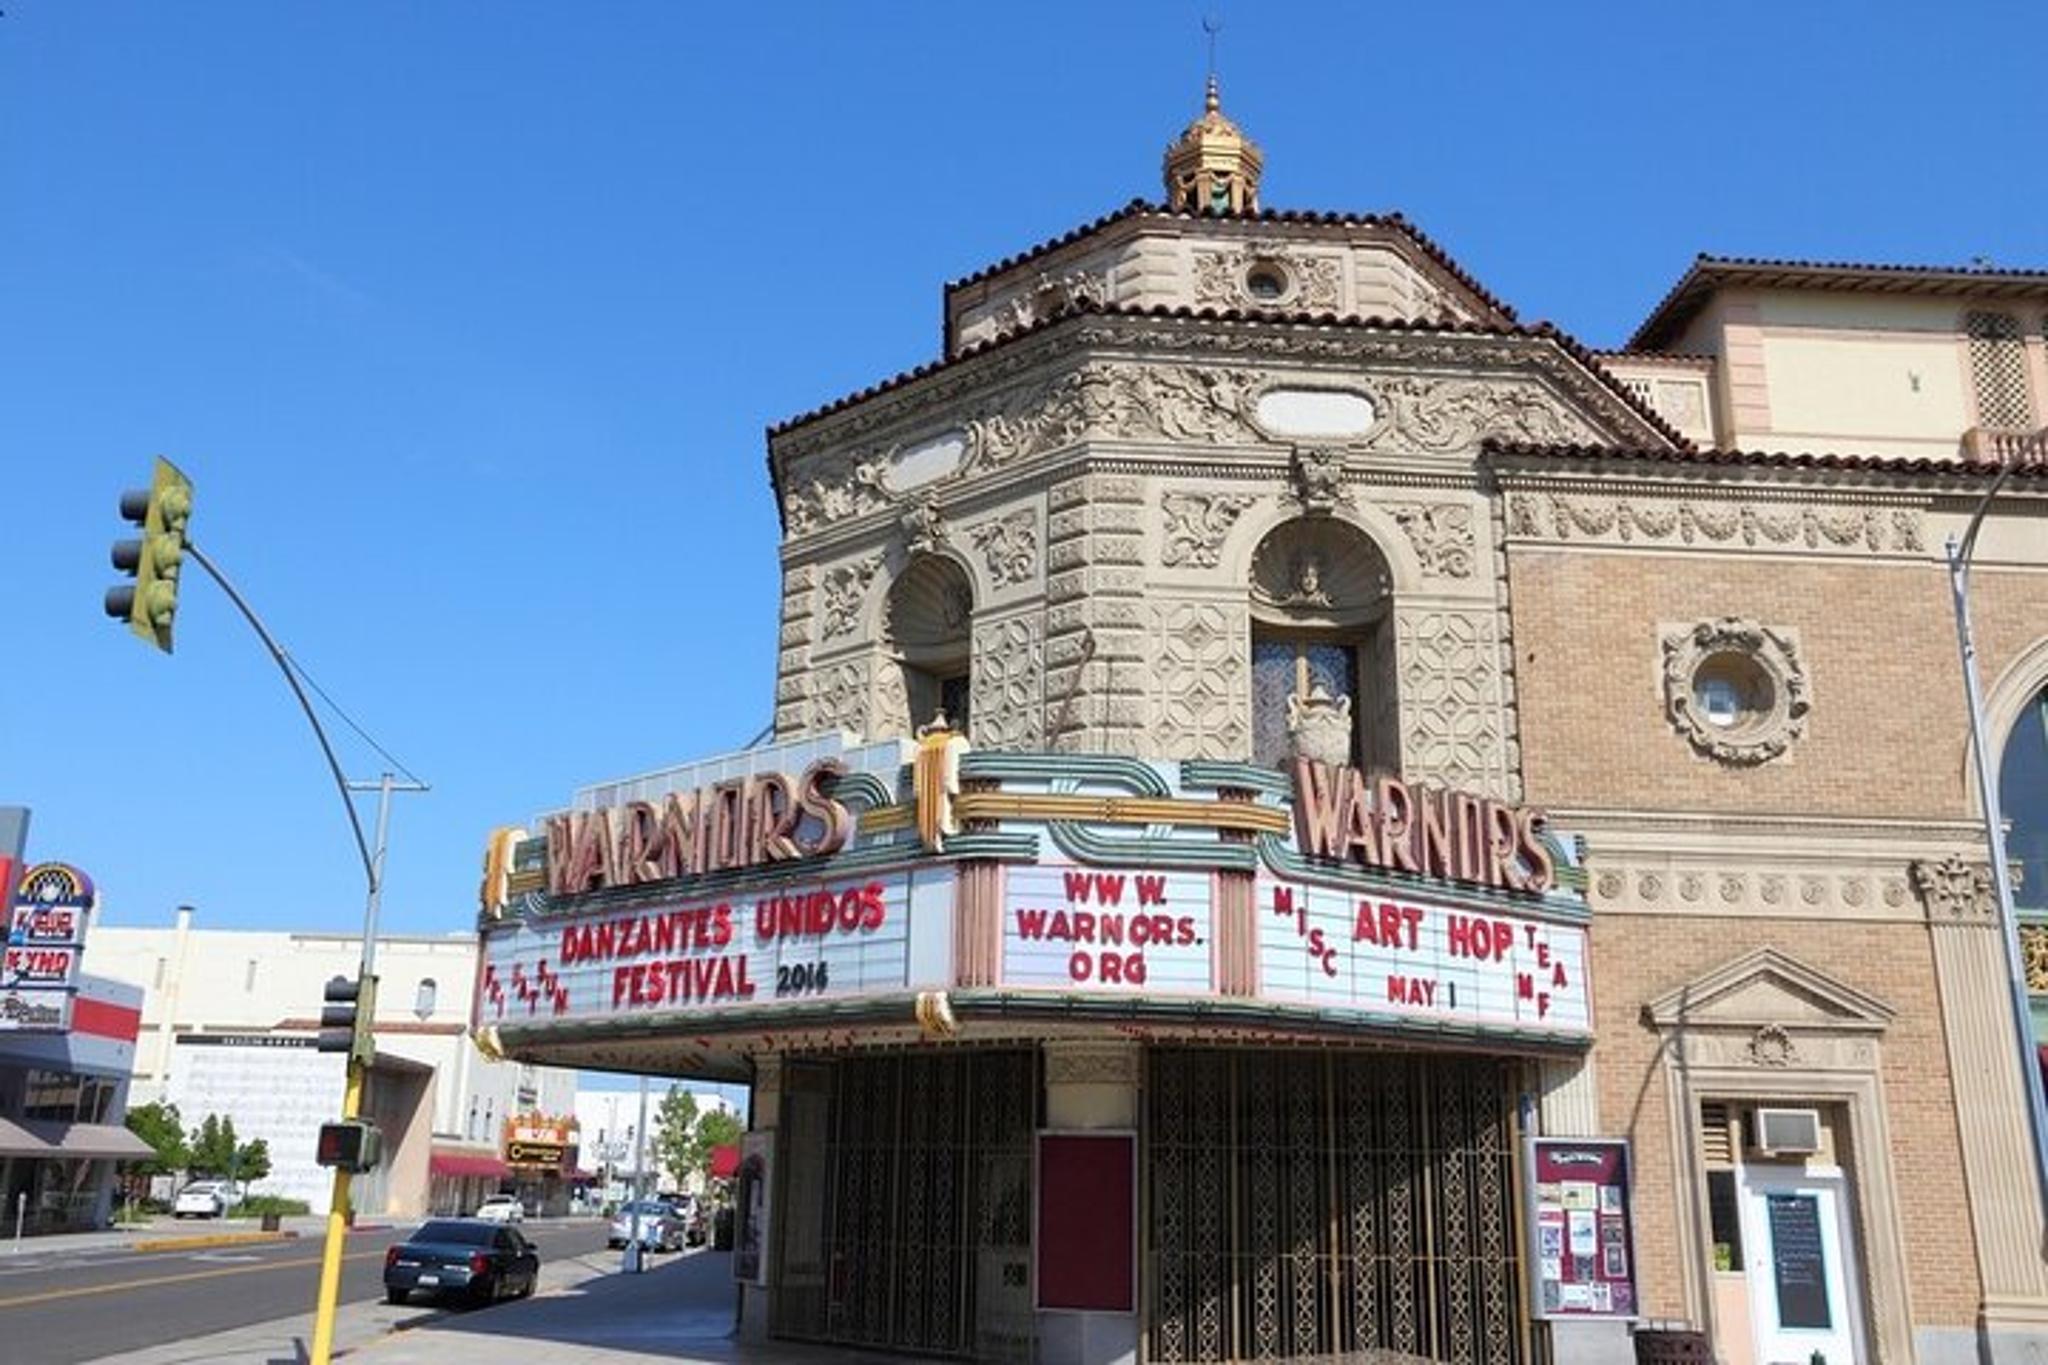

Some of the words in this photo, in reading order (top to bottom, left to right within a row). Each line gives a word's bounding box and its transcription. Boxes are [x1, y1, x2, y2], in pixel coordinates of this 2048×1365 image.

[561, 903, 733, 963] DANZANTES
[755, 881, 886, 937] UNIDOS
[1016, 909, 1203, 947] WARNORS.
[1353, 900, 1424, 951] ART
[1447, 914, 1513, 963] HOP
[613, 956, 755, 1008] FESTIVAL
[1068, 951, 1147, 985] ORG
[1387, 974, 1437, 1008] MAY
